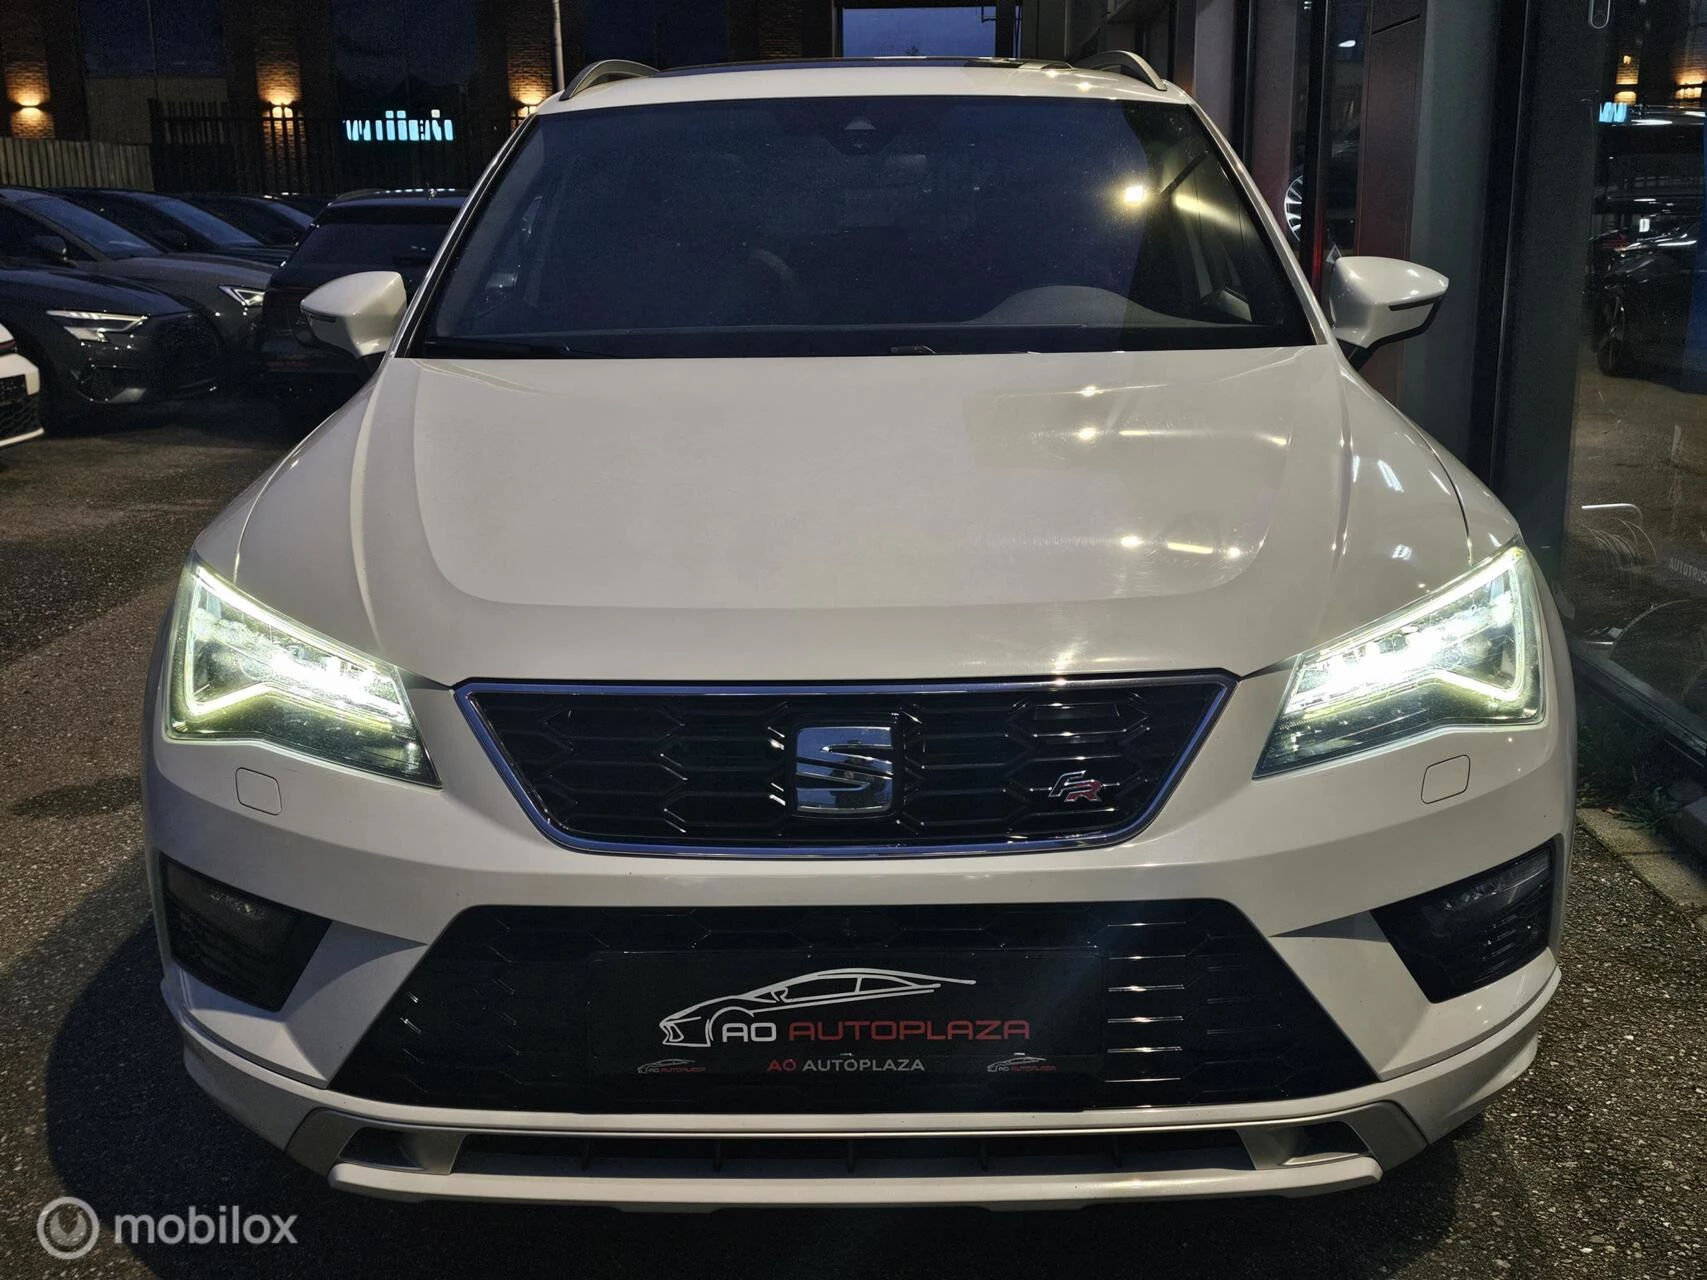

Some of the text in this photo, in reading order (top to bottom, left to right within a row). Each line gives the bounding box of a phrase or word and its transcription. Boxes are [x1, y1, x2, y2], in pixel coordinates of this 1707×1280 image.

[1048, 770, 1103, 802] FR
[722, 1019, 1030, 1043] AO AUTOPLAZA
[767, 1058, 925, 1072] AO AUTOPLAZA
